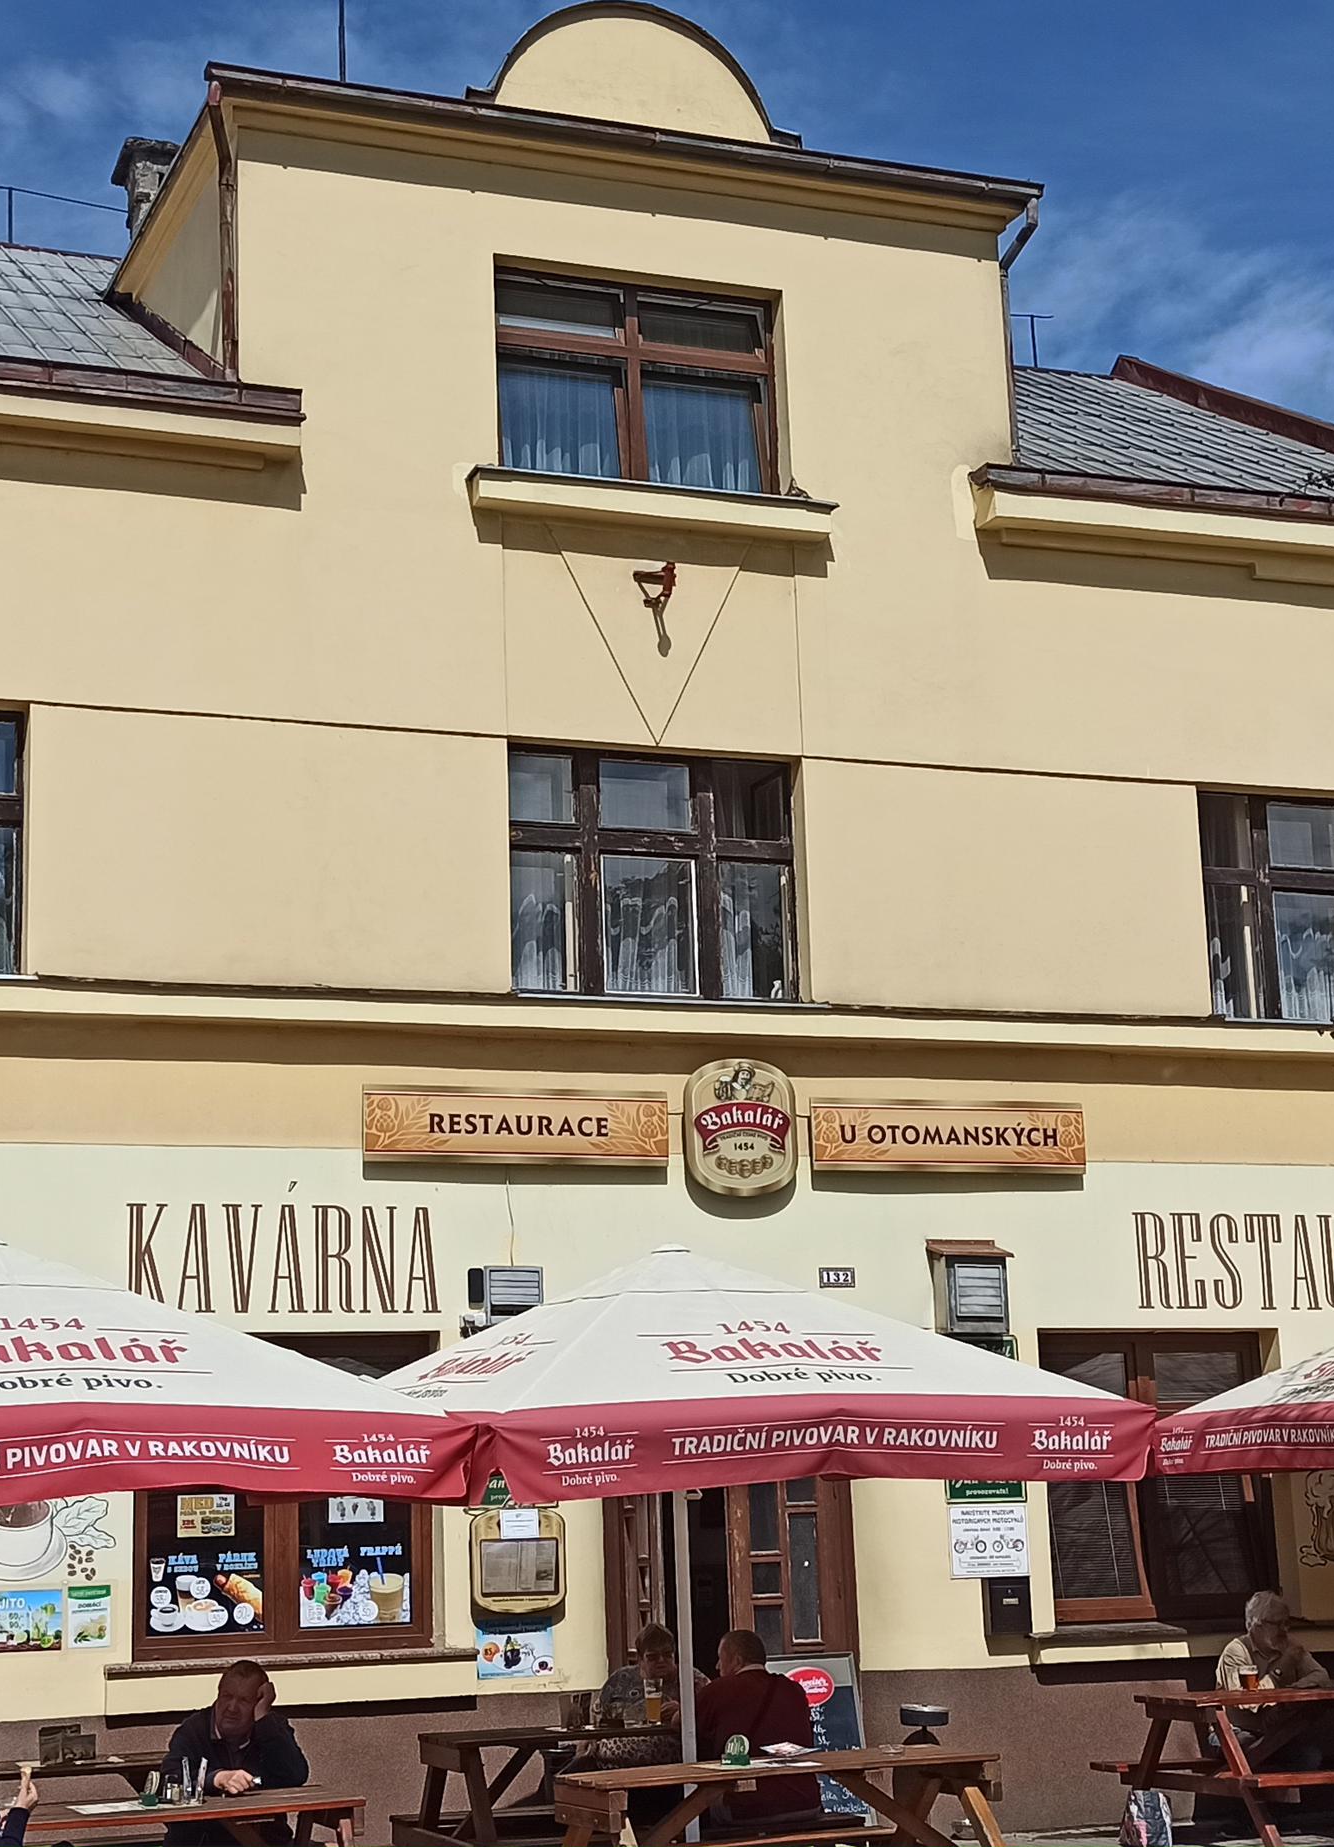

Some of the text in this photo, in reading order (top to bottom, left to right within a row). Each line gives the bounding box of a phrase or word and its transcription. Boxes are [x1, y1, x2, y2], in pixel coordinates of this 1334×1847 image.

[428, 1111, 610, 1138] RESTAURACE
[700, 1106, 785, 1130] Bakalář
[840, 1122, 1059, 1147] U OTOMANSKÝCH
[734, 1142, 755, 1151] 1454
[126, 1181, 442, 1314] KAVÁRNA
[826, 1272, 849, 1283] 132
[718, 1320, 791, 1335] 1454
[659, 1337, 883, 1365] Bakalář
[83, 1374, 164, 1390] pivo.
[726, 1367, 882, 1384] Dobré pivo.
[1059, 1416, 1085, 1427] 1454
[361, 1434, 395, 1443] 1454
[574, 1426, 605, 1438] 1454
[671, 1425, 999, 1456] TRADIČNÍ PIVOVAR V RAKOVNÍKU
[1030, 1429, 1112, 1450] Bakalář
[1205, 1429, 1243, 1449] TRADIČNÍ
[1242, 1428, 1282, 1445] PIVOVAR
[1283, 1428, 1289, 1442] V
[1161, 1434, 1193, 1452] Bakalář
[6, 1438, 120, 1469] PIVOVAR
[124, 1440, 141, 1457] V
[149, 1439, 290, 1465] RAKOVNÍKU
[332, 1444, 431, 1464] Bakalář
[547, 1438, 635, 1466] Bakalář
[1043, 1459, 1098, 1472] Dobré pivo.
[351, 1471, 417, 1485] Dobré pivo.
[561, 1471, 621, 1486] Dobré pivo.
[360, 1543, 402, 1556] FRAPPÉ
